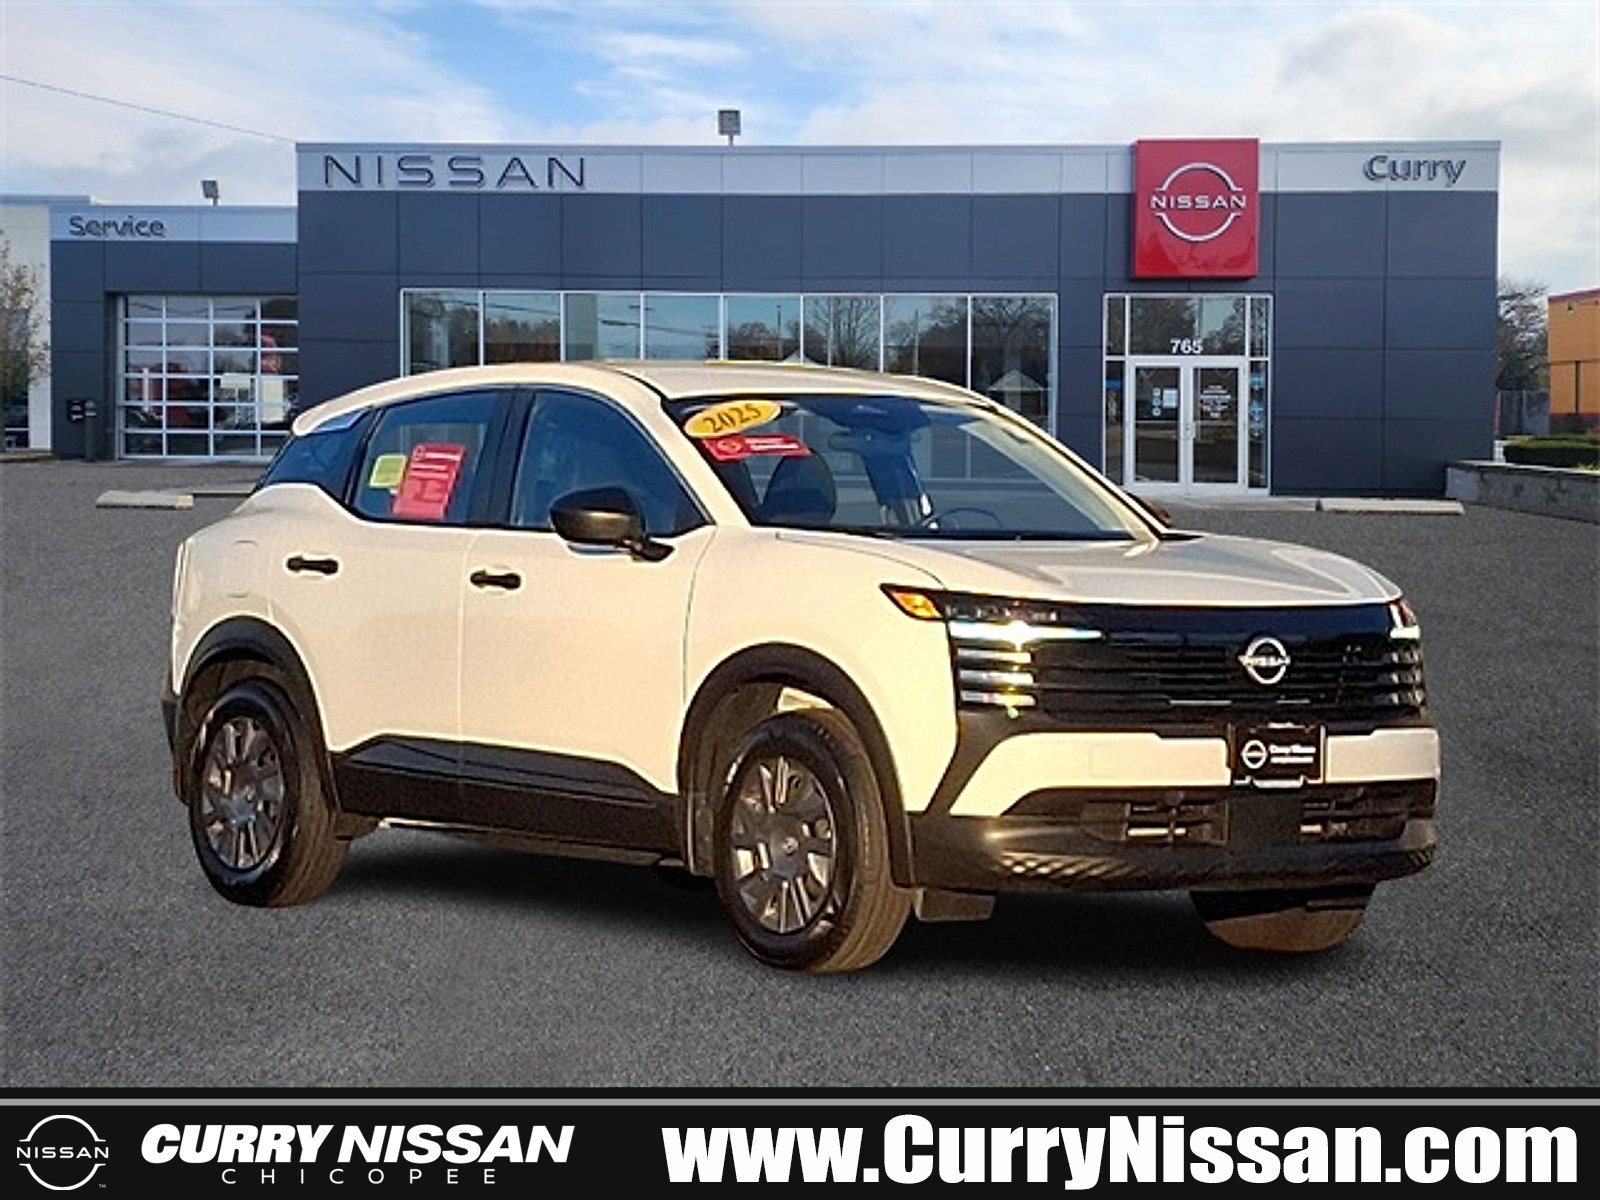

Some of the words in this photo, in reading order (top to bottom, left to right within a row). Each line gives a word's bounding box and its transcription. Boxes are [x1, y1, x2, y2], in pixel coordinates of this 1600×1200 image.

[323, 154, 587, 188] NISSAN
[1364, 154, 1466, 187] Curry
[1150, 194, 1246, 210] NISSAN
[69, 214, 165, 238] Service
[1170, 338, 1204, 354] 765
[703, 403, 762, 433] 2025
